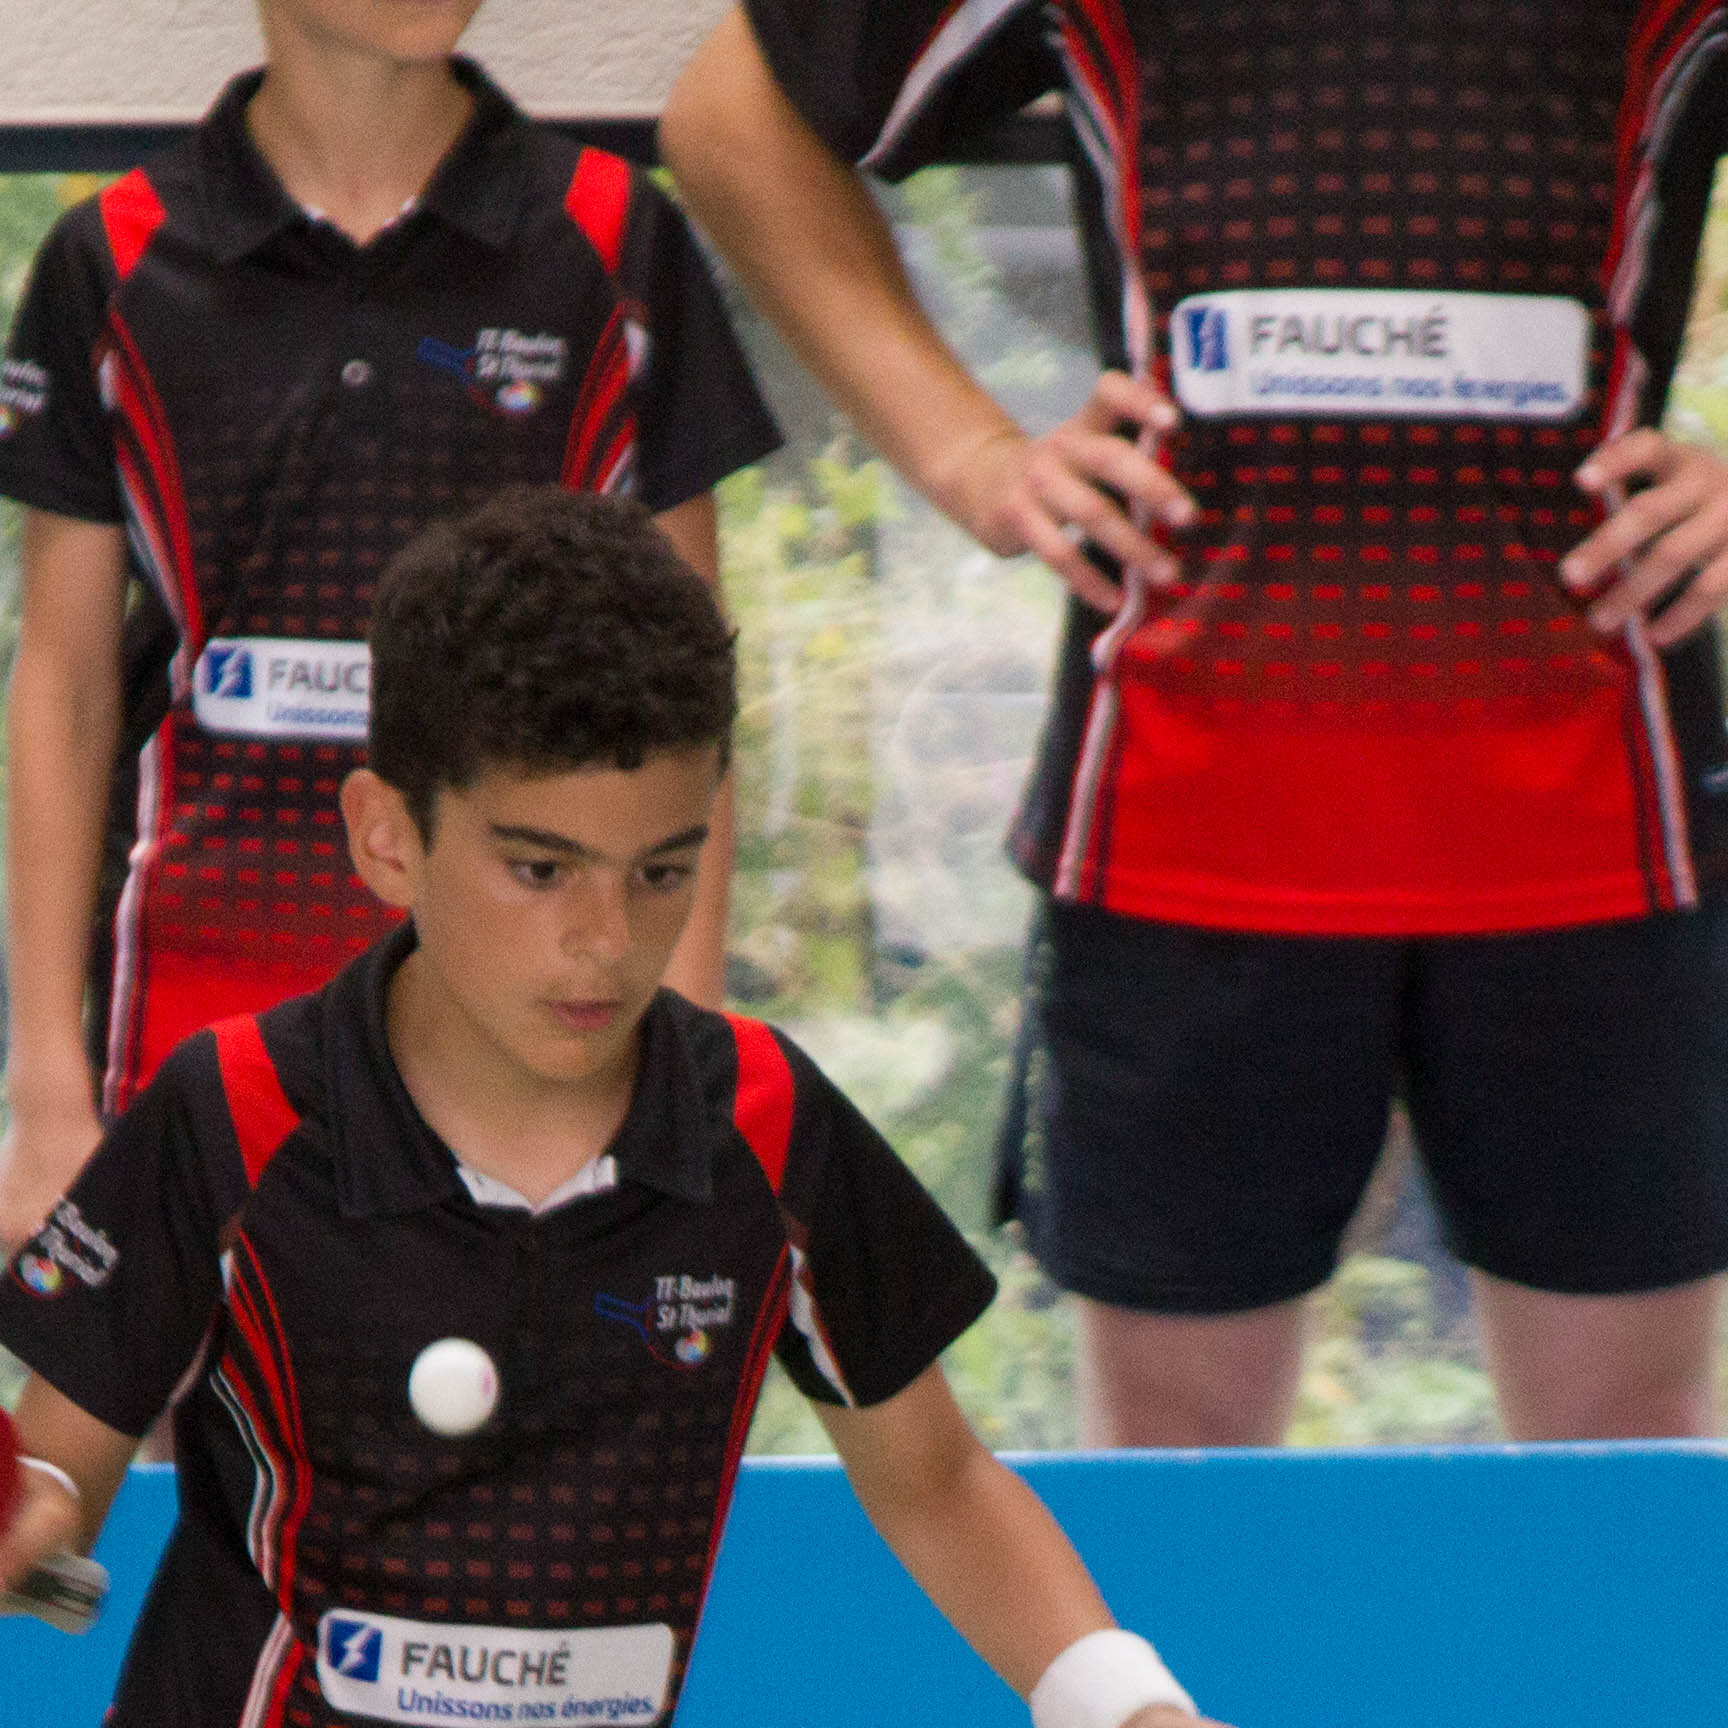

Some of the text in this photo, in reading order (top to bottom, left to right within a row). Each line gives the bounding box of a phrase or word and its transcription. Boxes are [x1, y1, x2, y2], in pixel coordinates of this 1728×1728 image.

[1250, 305, 1450, 358] FAUCHÉ
[268, 658, 368, 693] FAUC
[400, 1641, 572, 1687] FAUCHÉ
[397, 1687, 513, 1721] Unissons
[517, 1698, 556, 1720] nos
